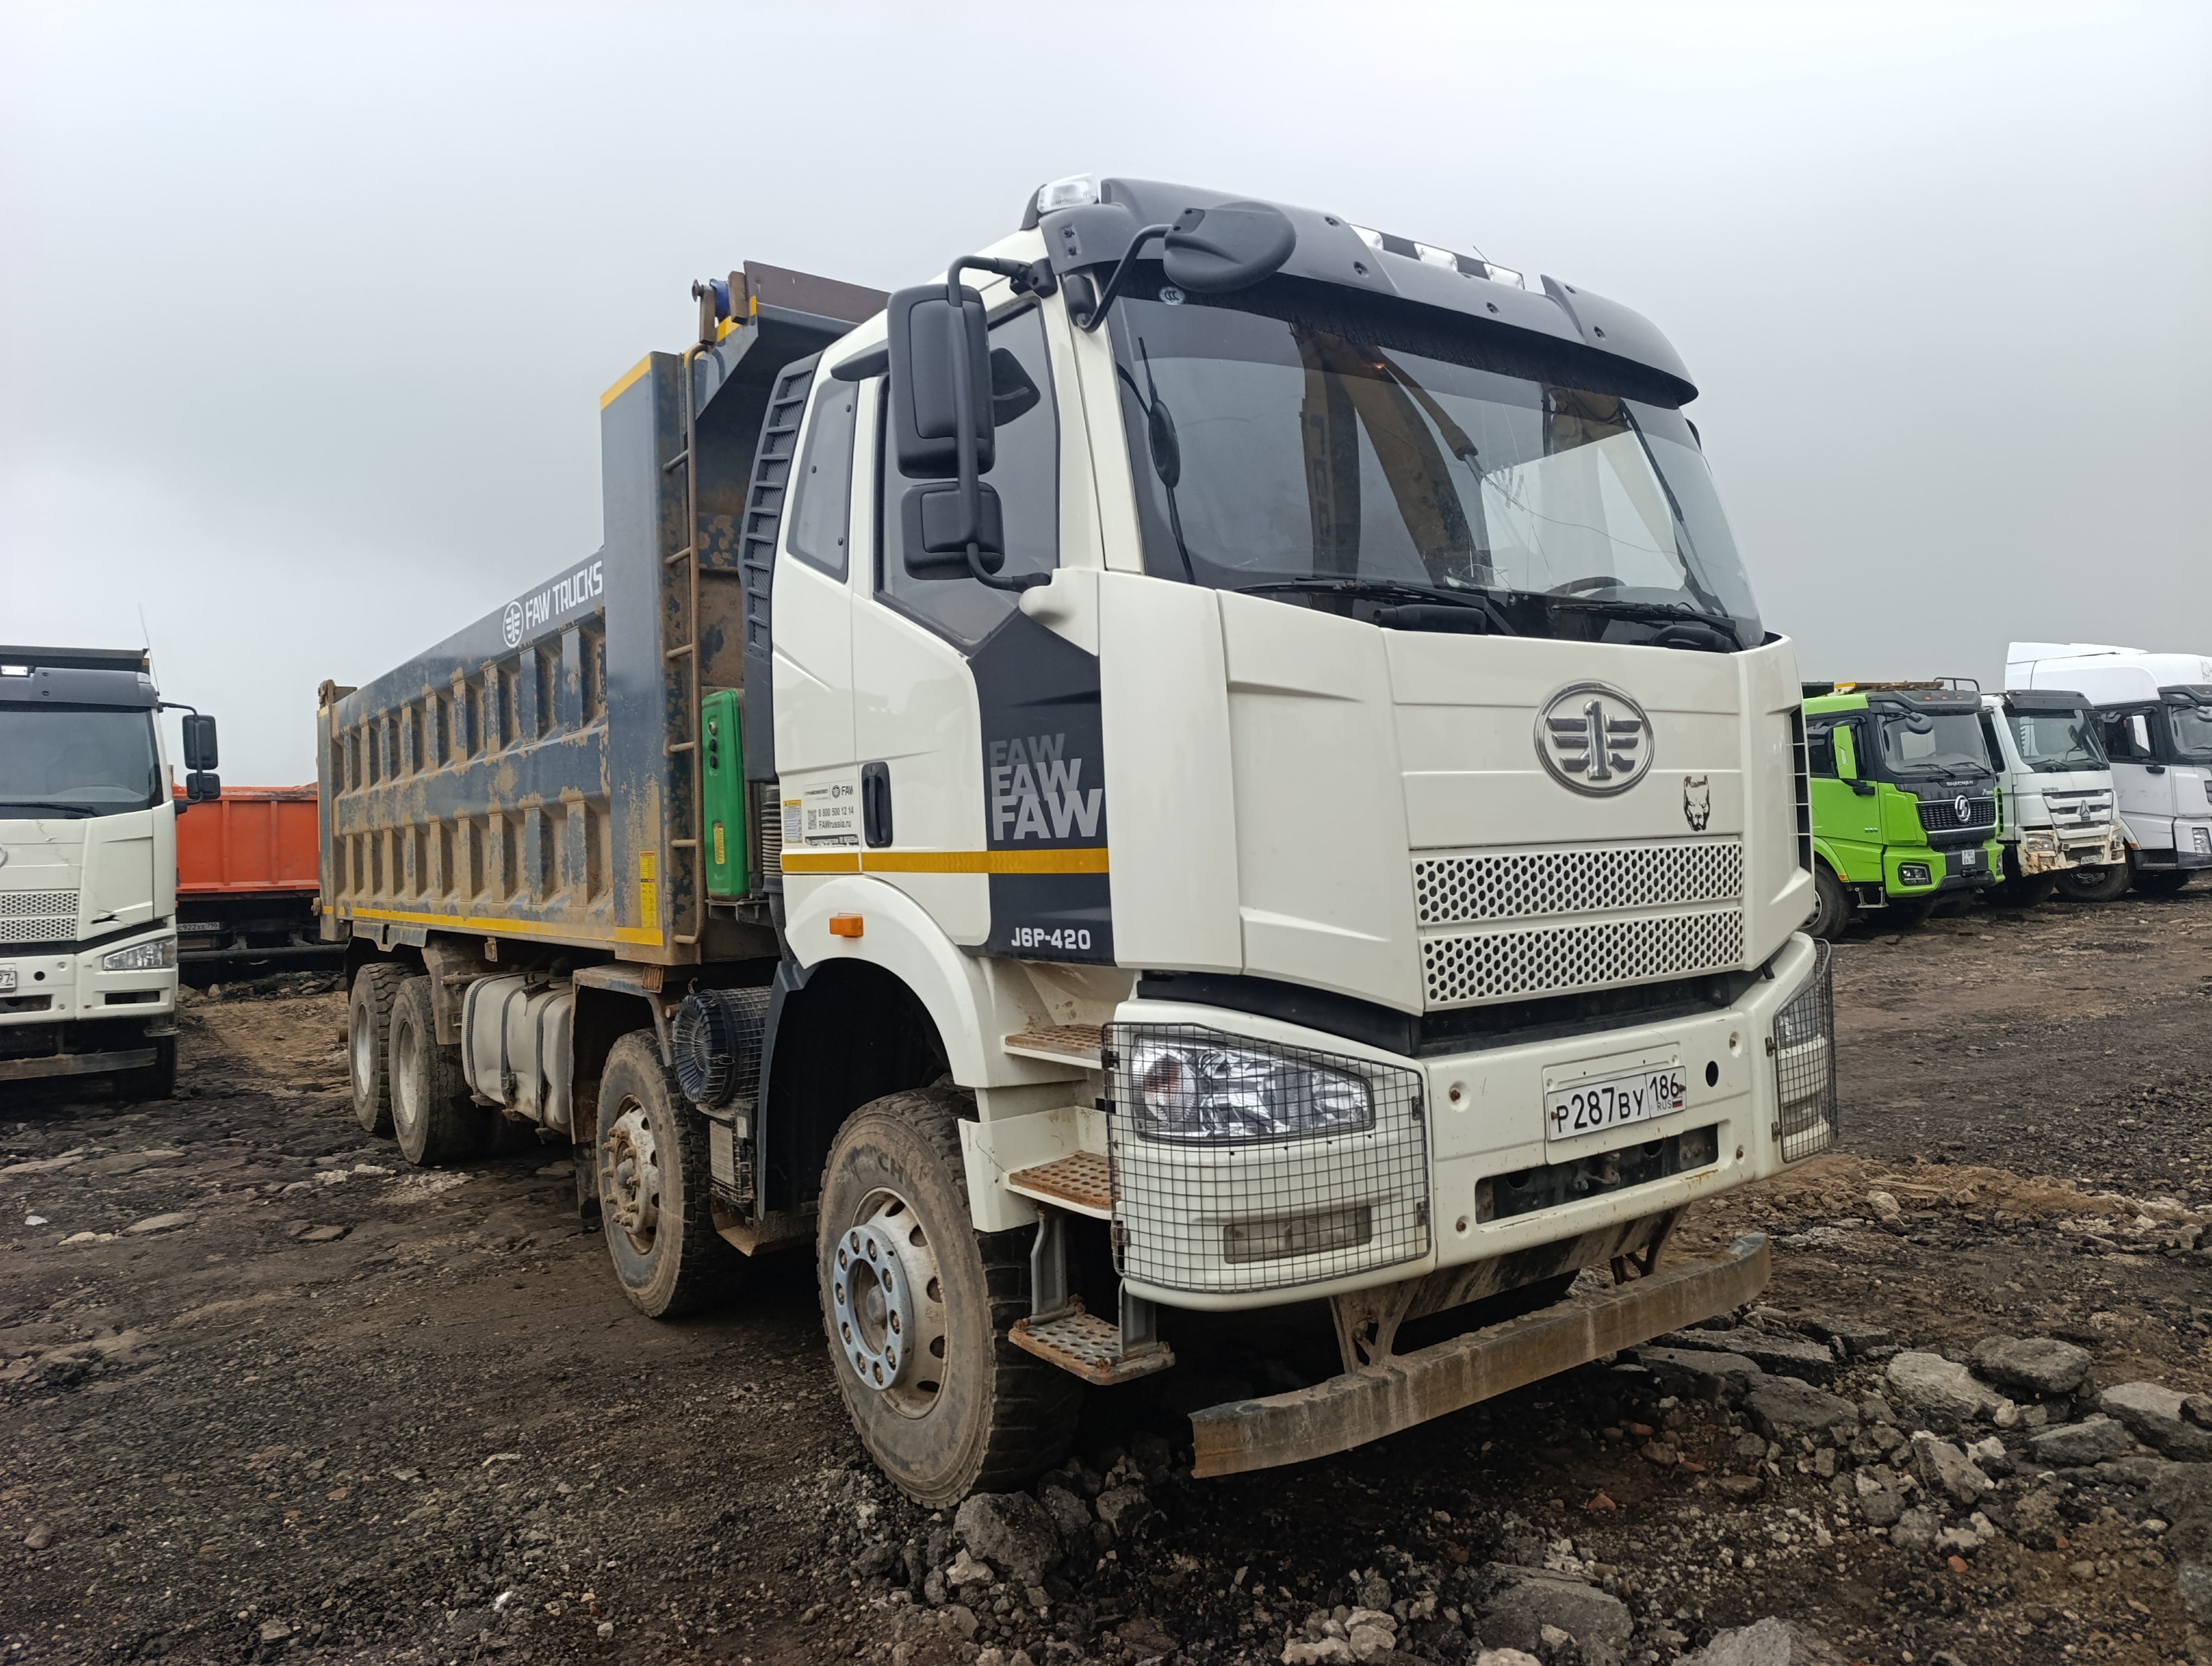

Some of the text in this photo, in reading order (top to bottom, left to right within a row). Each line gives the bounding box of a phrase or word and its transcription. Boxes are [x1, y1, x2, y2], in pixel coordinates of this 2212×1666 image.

[525, 560, 603, 630] FAW TRUCKS
[989, 733, 1065, 770] FAW
[990, 758, 1082, 803] FAW
[819, 819, 852, 829] FAWrussia.ru
[841, 806, 847, 815] 12
[848, 806, 854, 815] 14
[992, 788, 1103, 841] FAW
[1011, 927, 1091, 950] J6P-420
[1556, 1072, 1680, 1133] Р287ВУ 186
[1657, 1101, 1672, 1112] RUS
